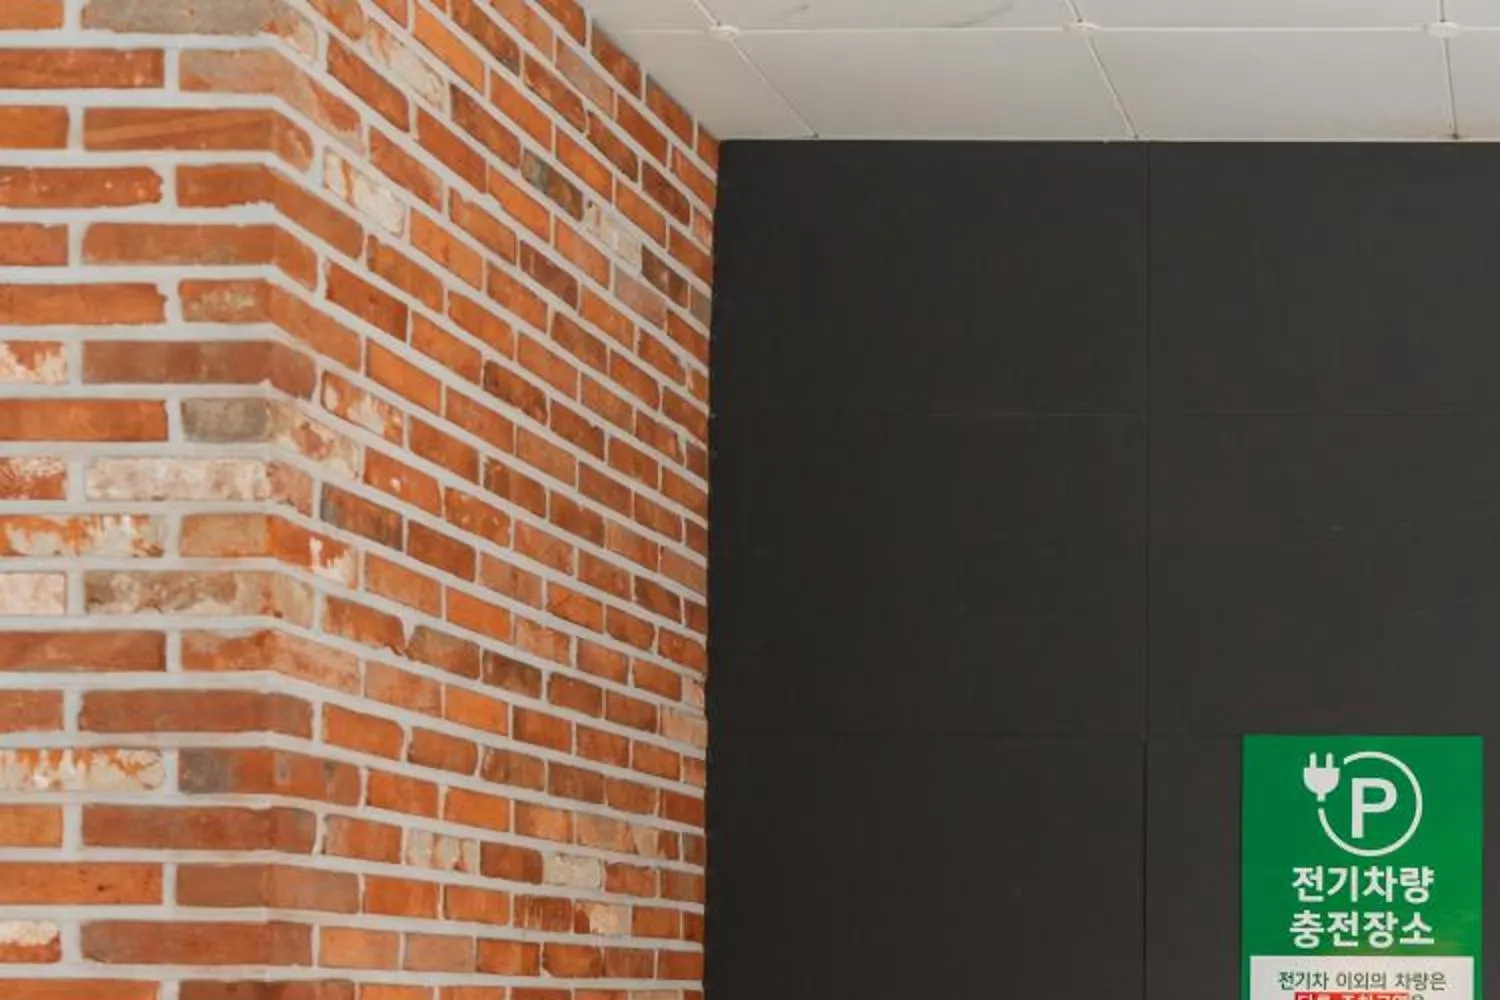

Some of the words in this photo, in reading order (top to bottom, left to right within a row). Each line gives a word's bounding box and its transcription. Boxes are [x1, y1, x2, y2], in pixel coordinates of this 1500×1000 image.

[1351, 777, 1398, 838] P
[1291, 865, 1435, 904] 전기차량
[1289, 909, 1435, 949] 충전장소
[1278, 971, 1329, 991] 전기차
[1336, 971, 1387, 990] 이외의
[1395, 971, 1447, 991] 차량은
